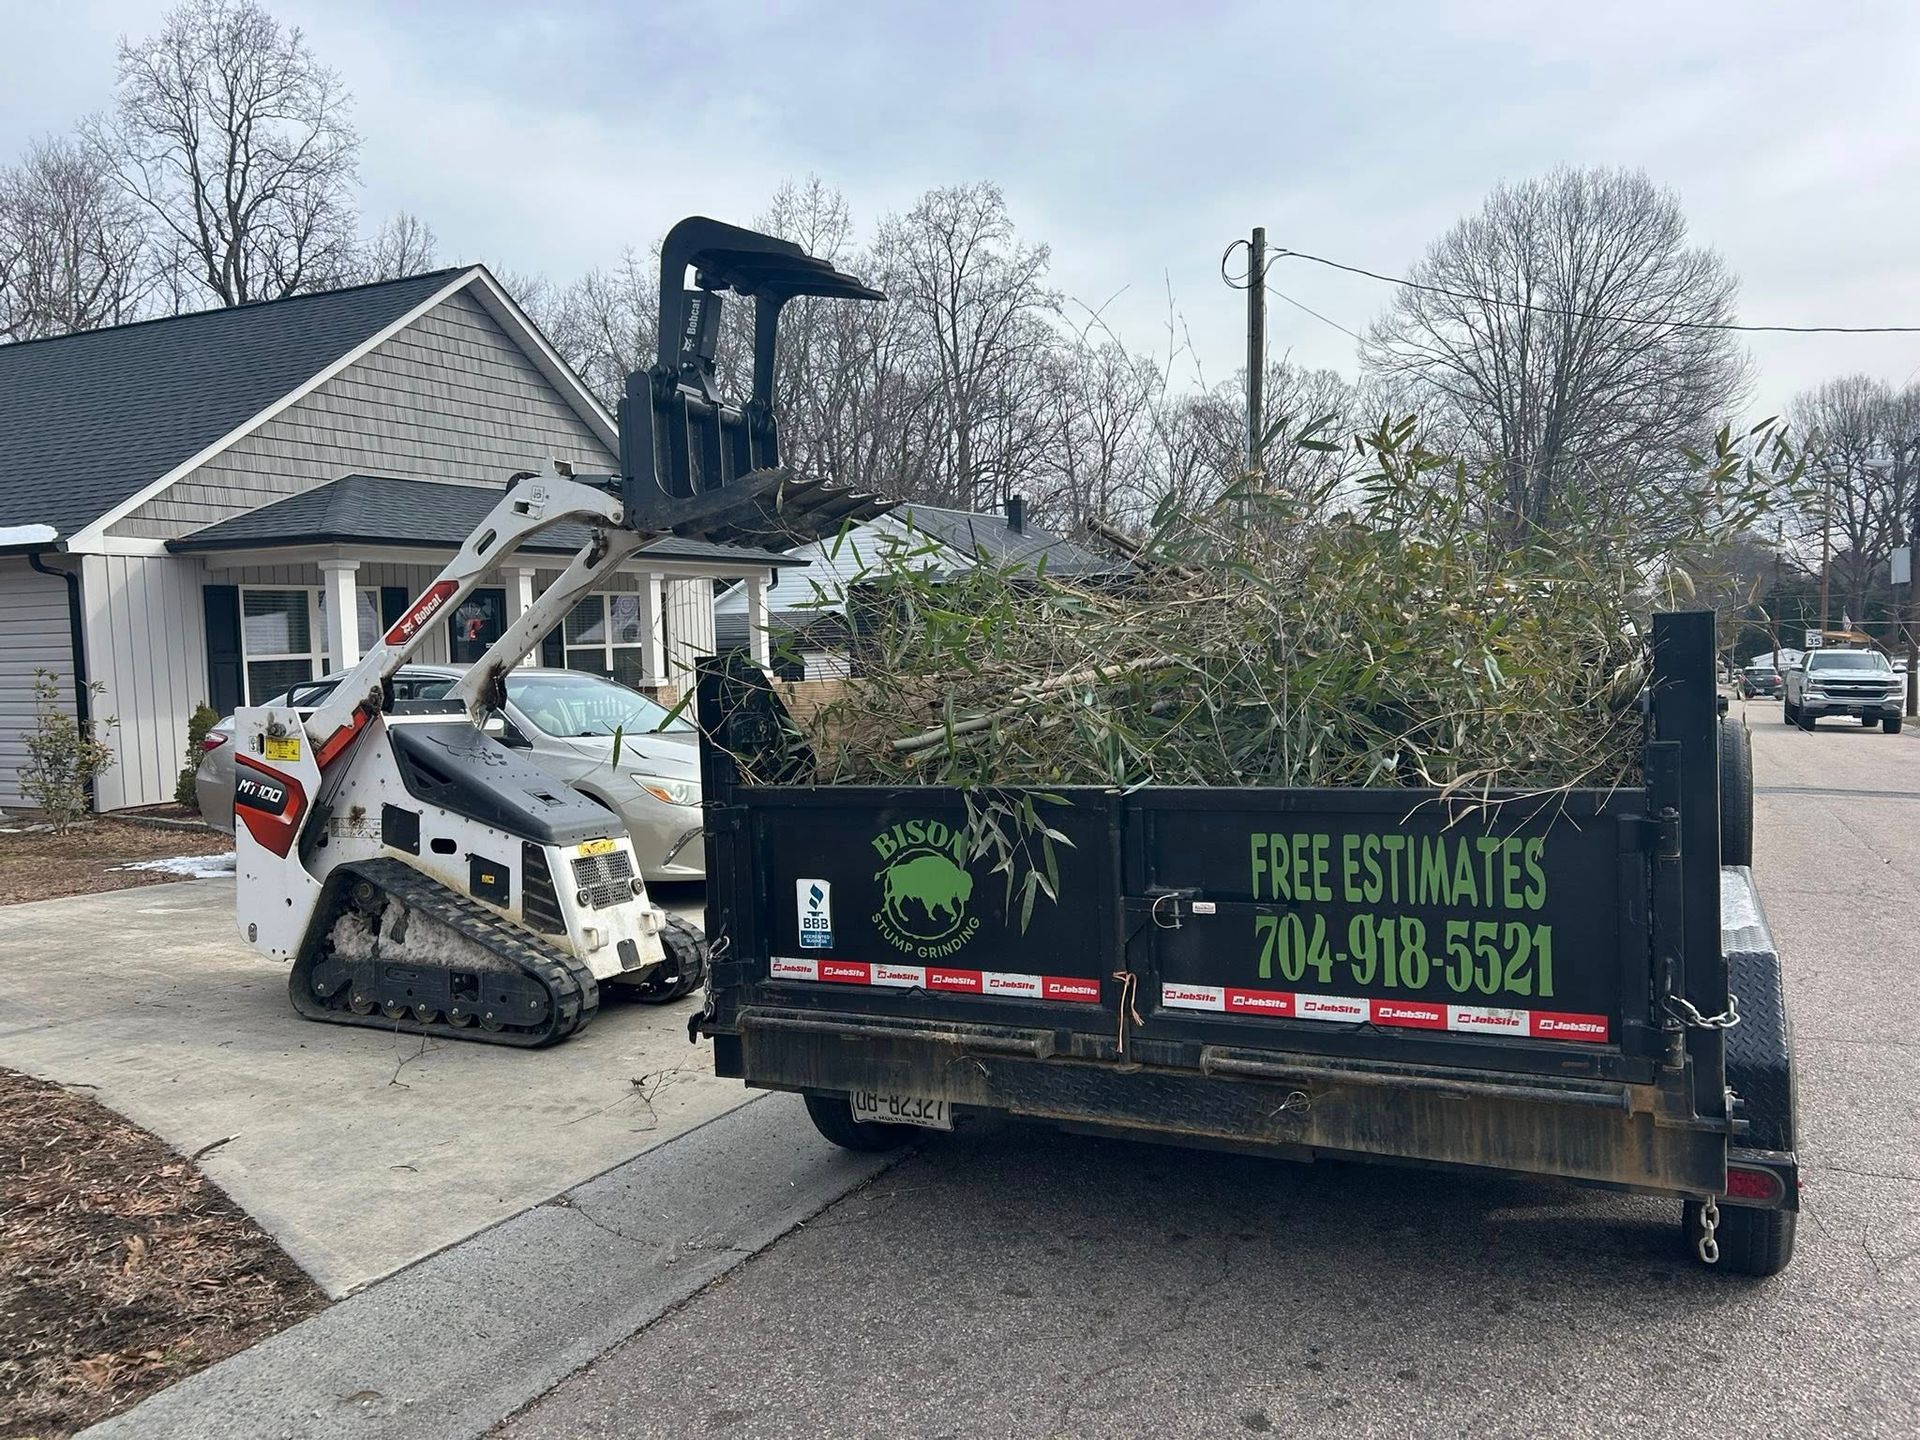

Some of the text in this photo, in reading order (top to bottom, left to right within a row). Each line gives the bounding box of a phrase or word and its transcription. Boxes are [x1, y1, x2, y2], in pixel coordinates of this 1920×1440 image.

[686, 299, 701, 335] Bobcat
[413, 593, 443, 626] Bobcat
[1251, 833, 1547, 911] FREE ESTIMATES
[803, 917, 829, 930] BBB
[872, 912, 980, 958] STUMP GRINDING
[1255, 911, 1555, 997] 704-918-5521
[782, 964, 812, 973] JobSite
[833, 968, 865, 977] JobSite
[887, 972, 919, 981] JobSite
[942, 976, 976, 986] JobSite
[1000, 980, 1035, 990] JobSite
[1060, 985, 1097, 995] JobSite
[1177, 992, 1216, 1002] JobSite
[1245, 997, 1288, 1009] JobSite
[1317, 1003, 1361, 1014] JobSite
[1392, 1009, 1439, 1021] JobSite
[1471, 1015, 1520, 1027] JobSite
[1554, 1021, 1605, 1033] JobSite
